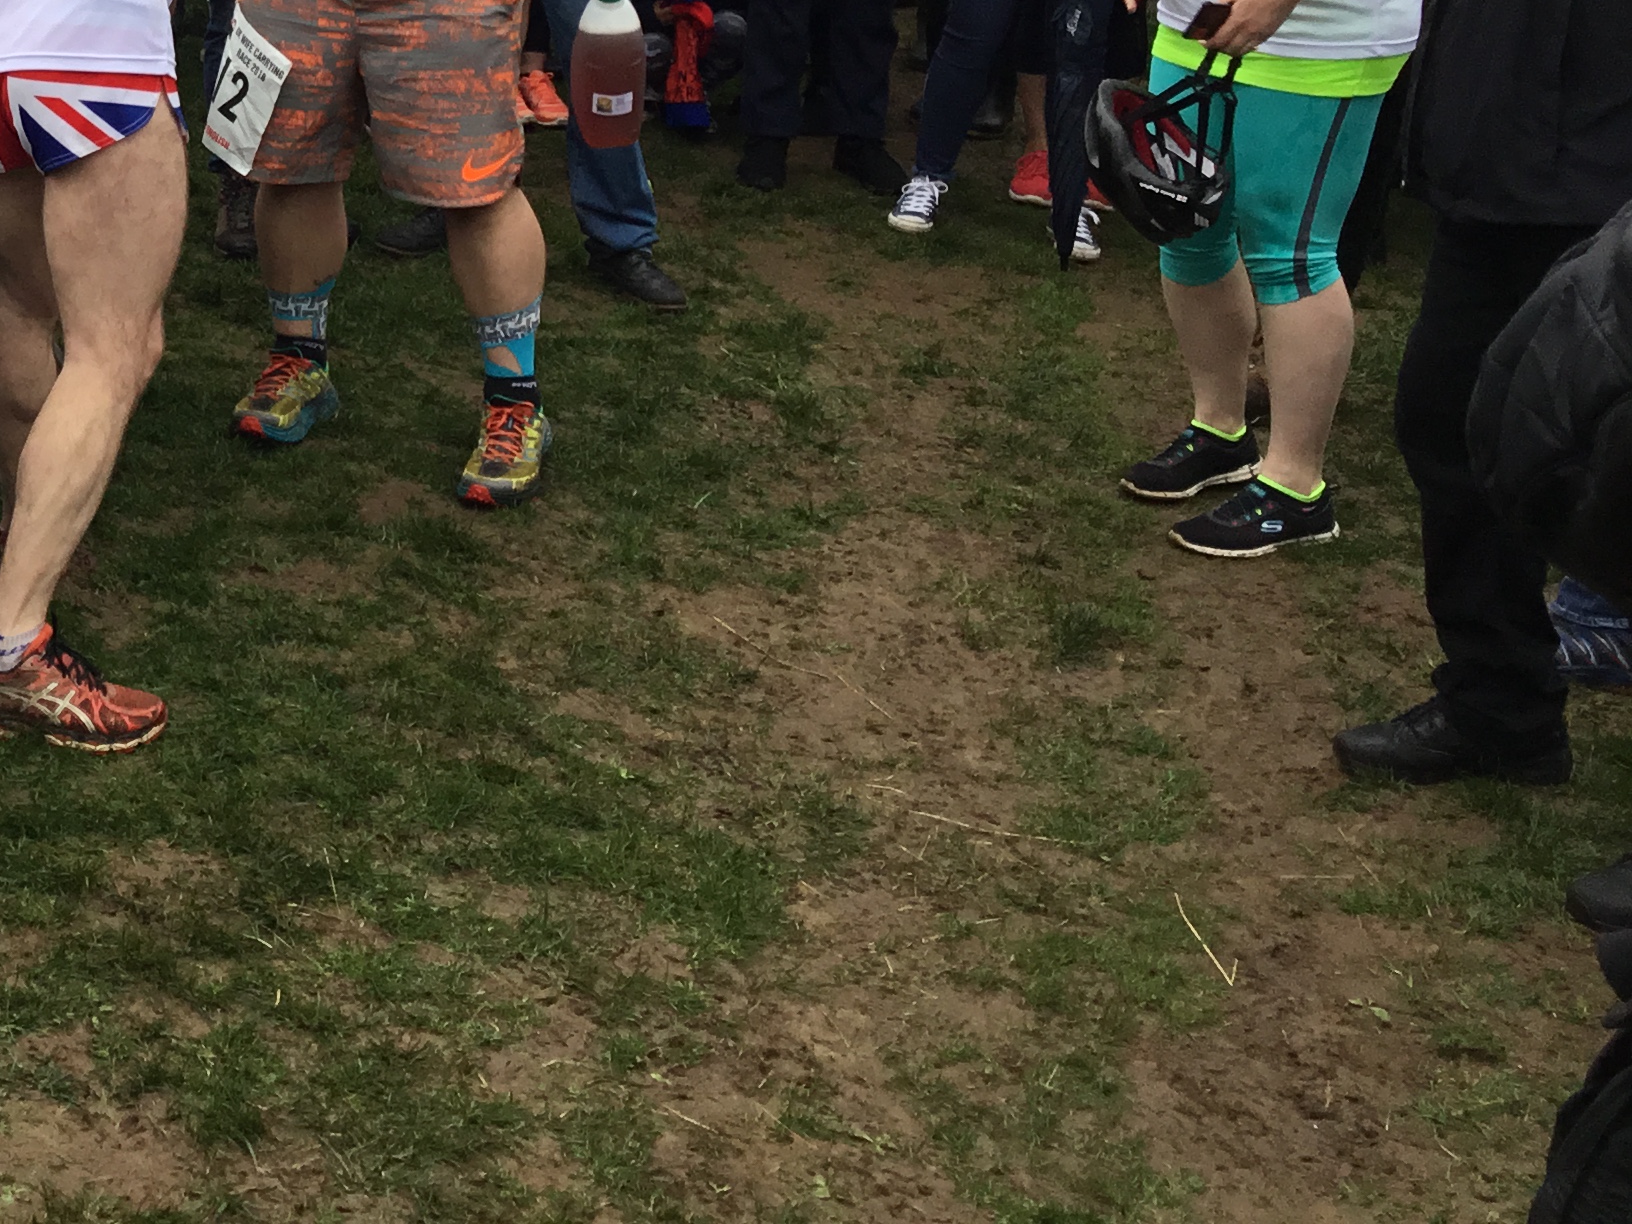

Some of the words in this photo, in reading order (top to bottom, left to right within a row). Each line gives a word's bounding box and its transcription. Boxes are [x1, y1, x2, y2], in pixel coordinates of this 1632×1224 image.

[236, 47, 251, 69] RACE
[252, 62, 267, 83] 2018
[240, 34, 254, 53] WIFE
[253, 48, 285, 80] CARRYING
